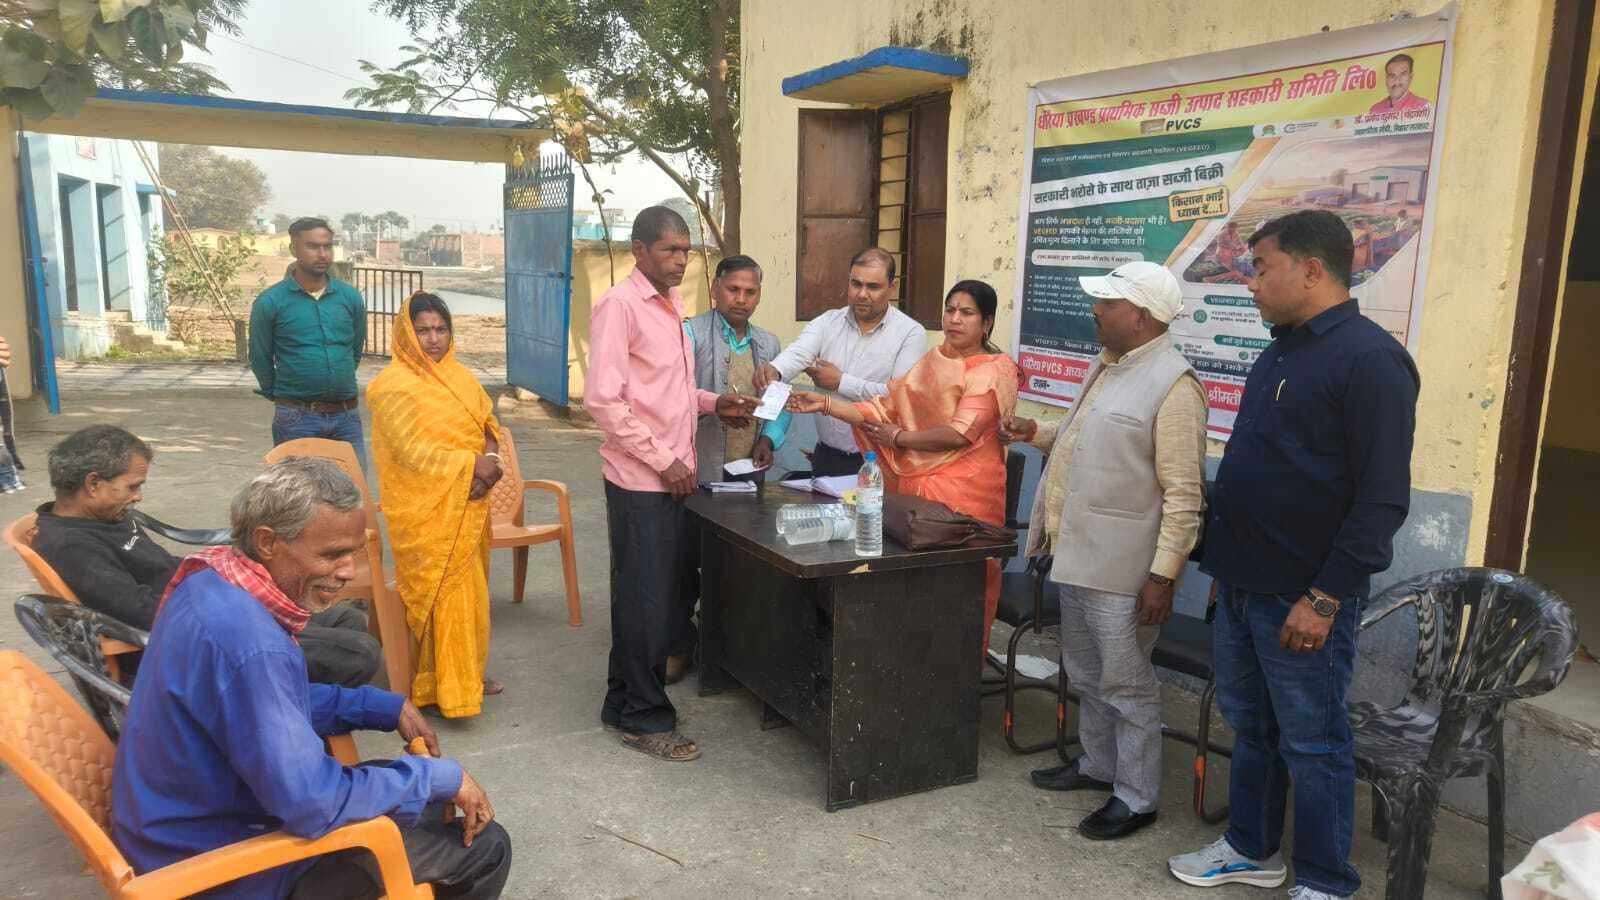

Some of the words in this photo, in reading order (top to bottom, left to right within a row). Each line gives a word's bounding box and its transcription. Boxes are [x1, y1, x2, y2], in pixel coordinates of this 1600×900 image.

[1098, 100, 1147, 123] प्राथमिक
[1149, 93, 1182, 117] सब्जी
[1184, 92, 1224, 113] उत्पाद
[1227, 78, 1284, 108] सहकारी
[1287, 69, 1341, 99] समिति
[1165, 118, 1201, 132] PVCS
[1034, 187, 1069, 204] सरकारी
[1071, 183, 1095, 199] भरोसे
[1097, 181, 1107, 194] के
[1110, 179, 1133, 193] साथ
[1162, 168, 1192, 186] सब्जी
[1195, 162, 1224, 181] बिक्री
[1172, 196, 1203, 208] किसान
[1206, 188, 1223, 202] भाई
[1177, 207, 1200, 217] ध्यान
[1041, 361, 1063, 375] PVCS
